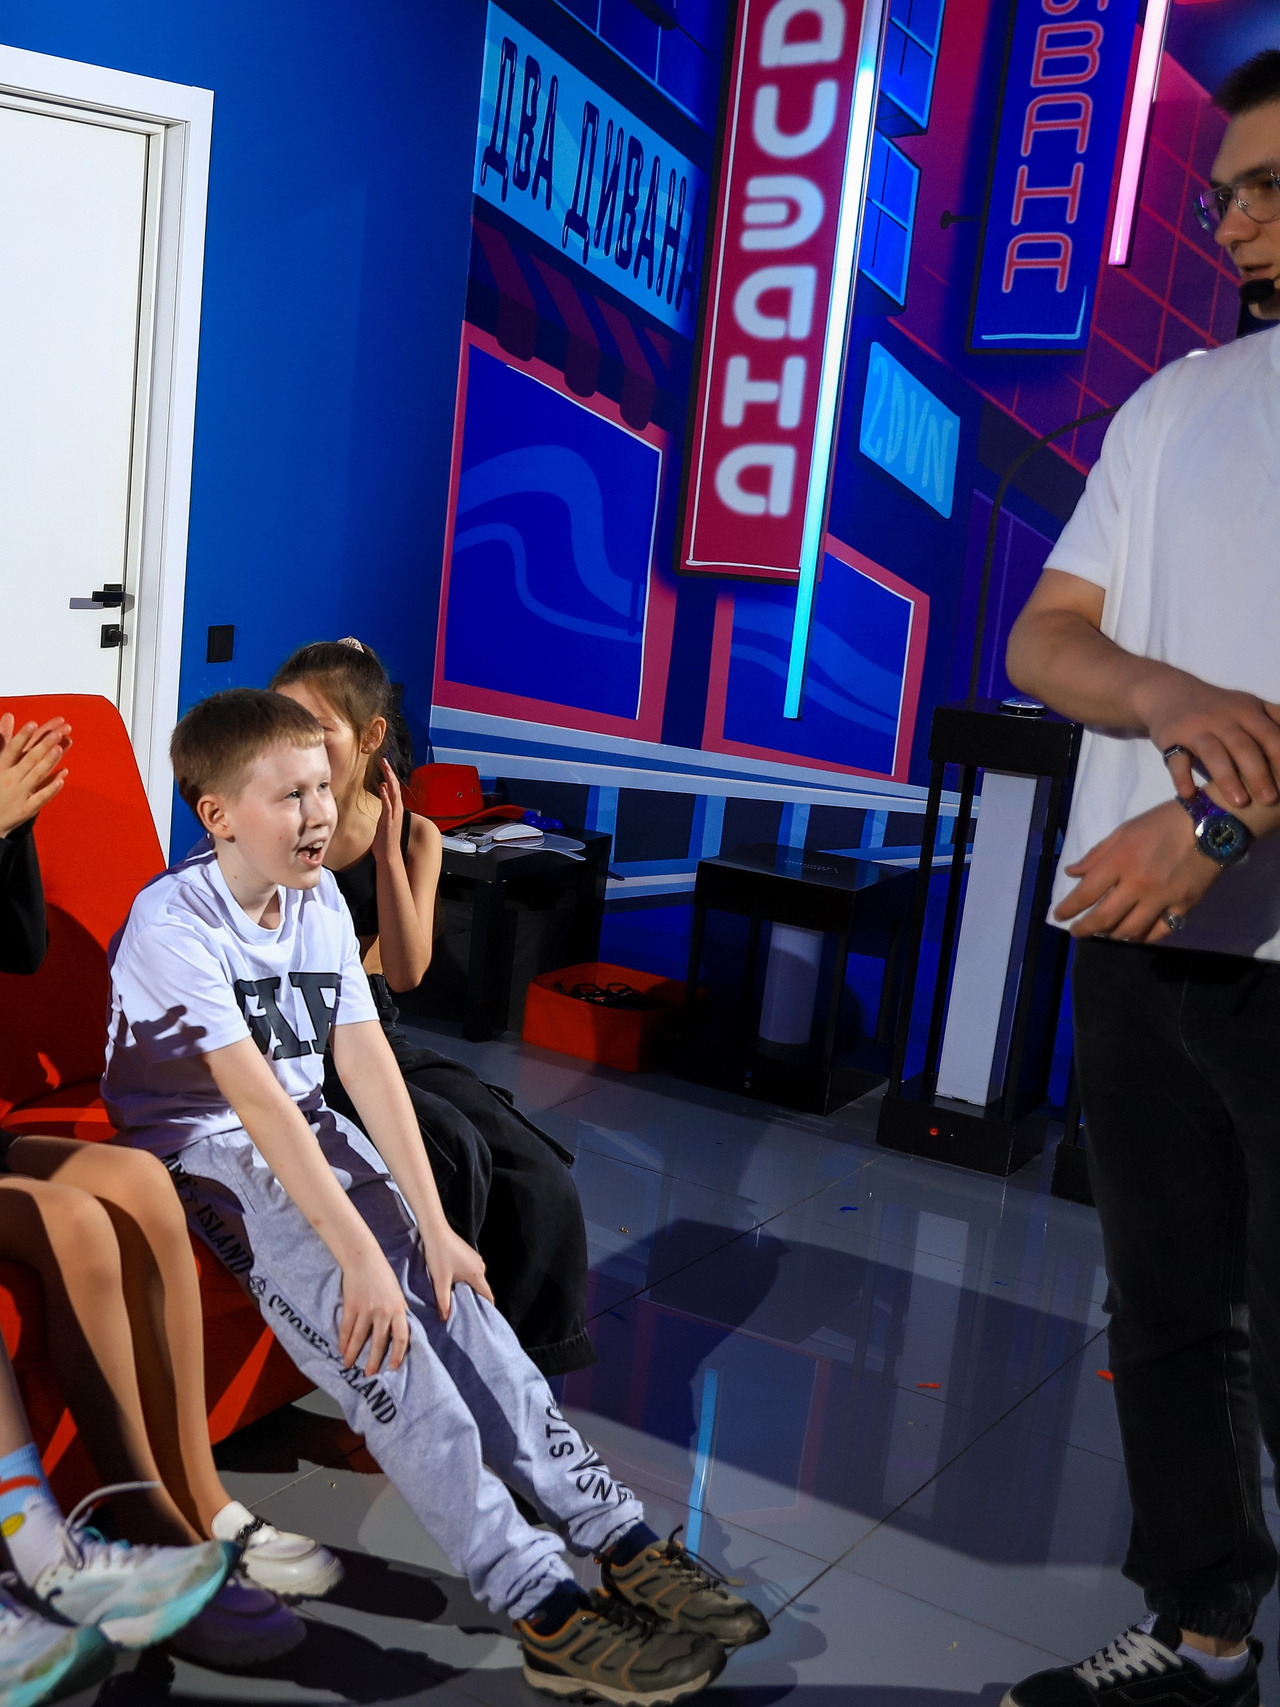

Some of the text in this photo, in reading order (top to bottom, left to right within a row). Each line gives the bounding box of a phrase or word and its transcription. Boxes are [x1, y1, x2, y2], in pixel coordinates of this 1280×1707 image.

[480, 36, 703, 323] ДВА ДИВАНА
[1002, 0, 1109, 293] ВАНА
[861, 356, 954, 503] 2DVN
